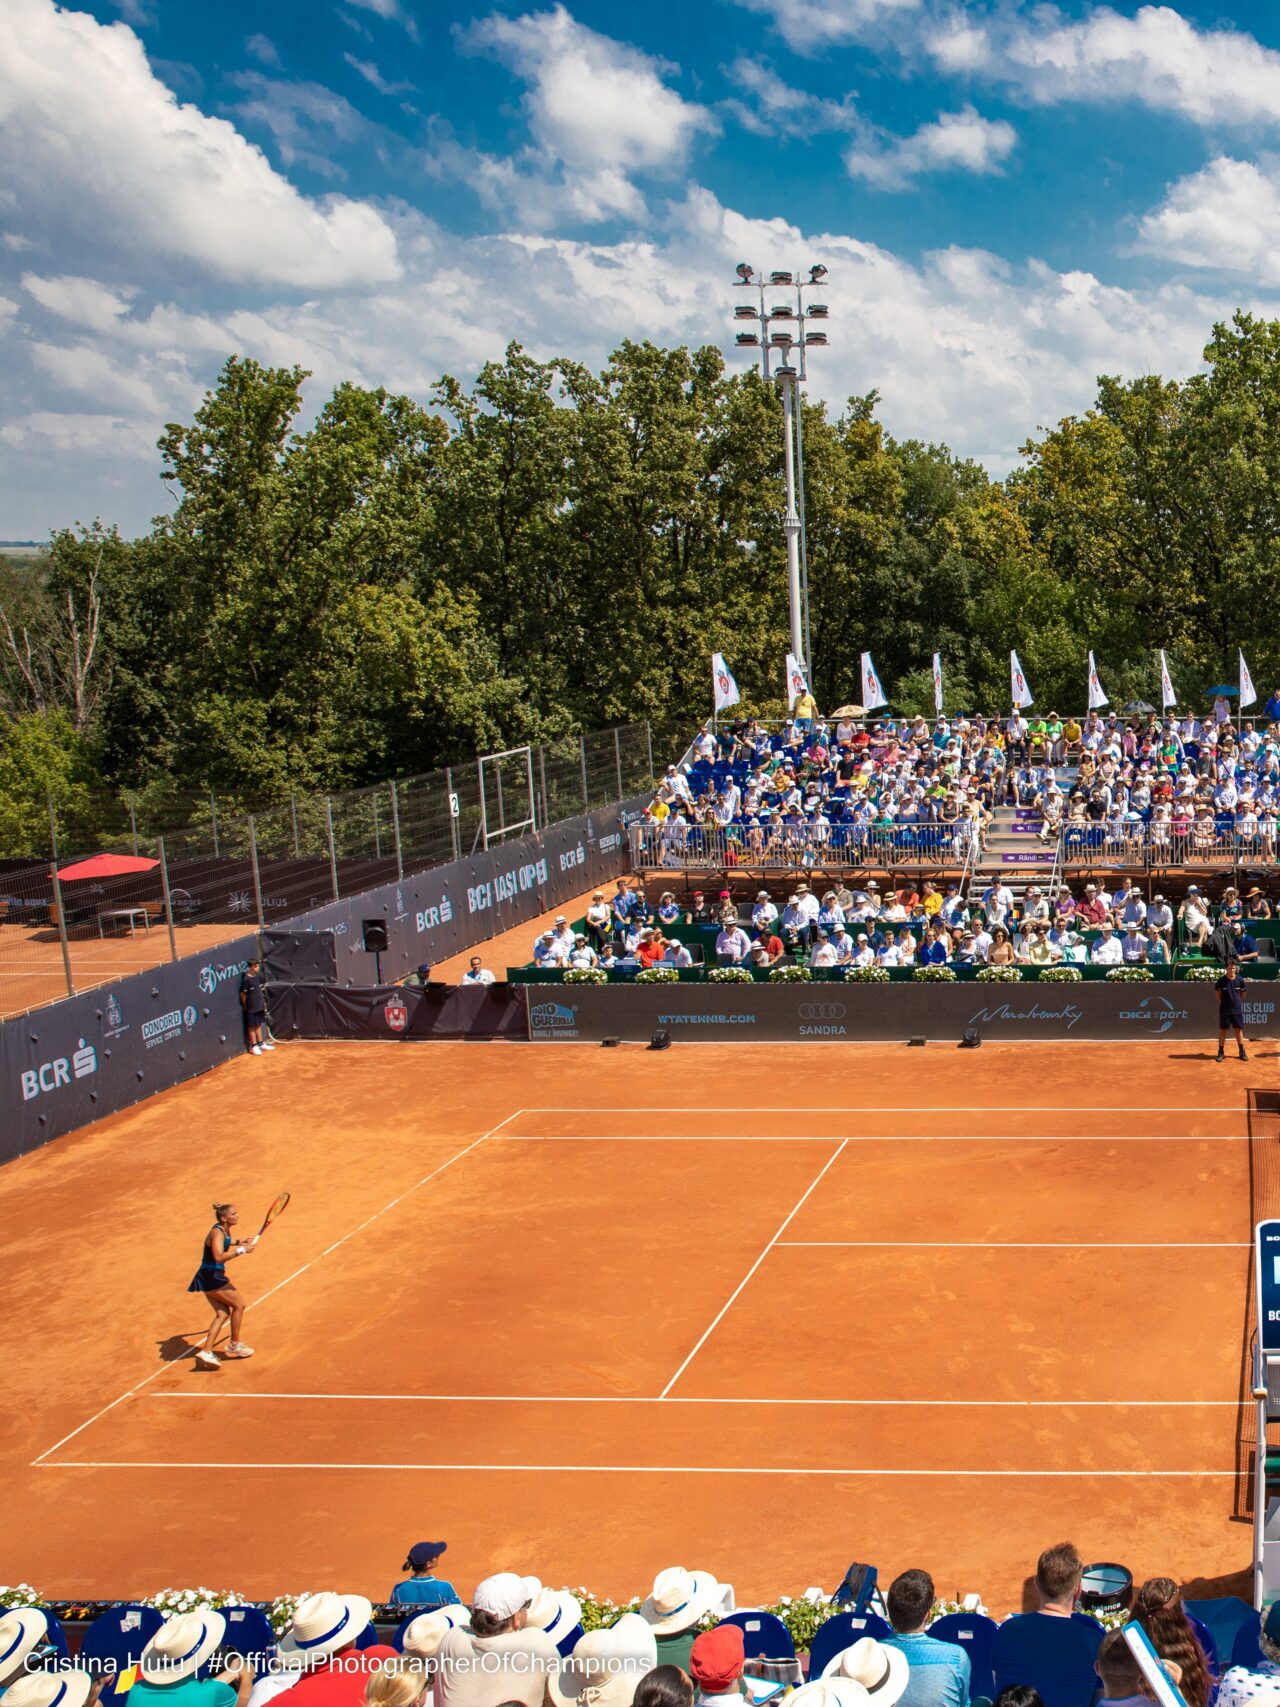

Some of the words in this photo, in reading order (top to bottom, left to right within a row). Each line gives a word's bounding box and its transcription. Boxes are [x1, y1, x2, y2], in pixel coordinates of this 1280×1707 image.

[452, 797, 458, 813] 2
[560, 851, 577, 871] BCR
[416, 905, 441, 932] BCR
[1254, 1003, 1275, 1012] CLUB
[658, 1015, 756, 1024] WTATENNIS.COM
[1119, 1011, 1152, 1019] DIGI
[143, 1011, 181, 1038] CONCORD
[799, 1026, 846, 1035] SANDRA
[145, 1036, 163, 1049] SERVICE
[21, 1057, 72, 1101] BCR
